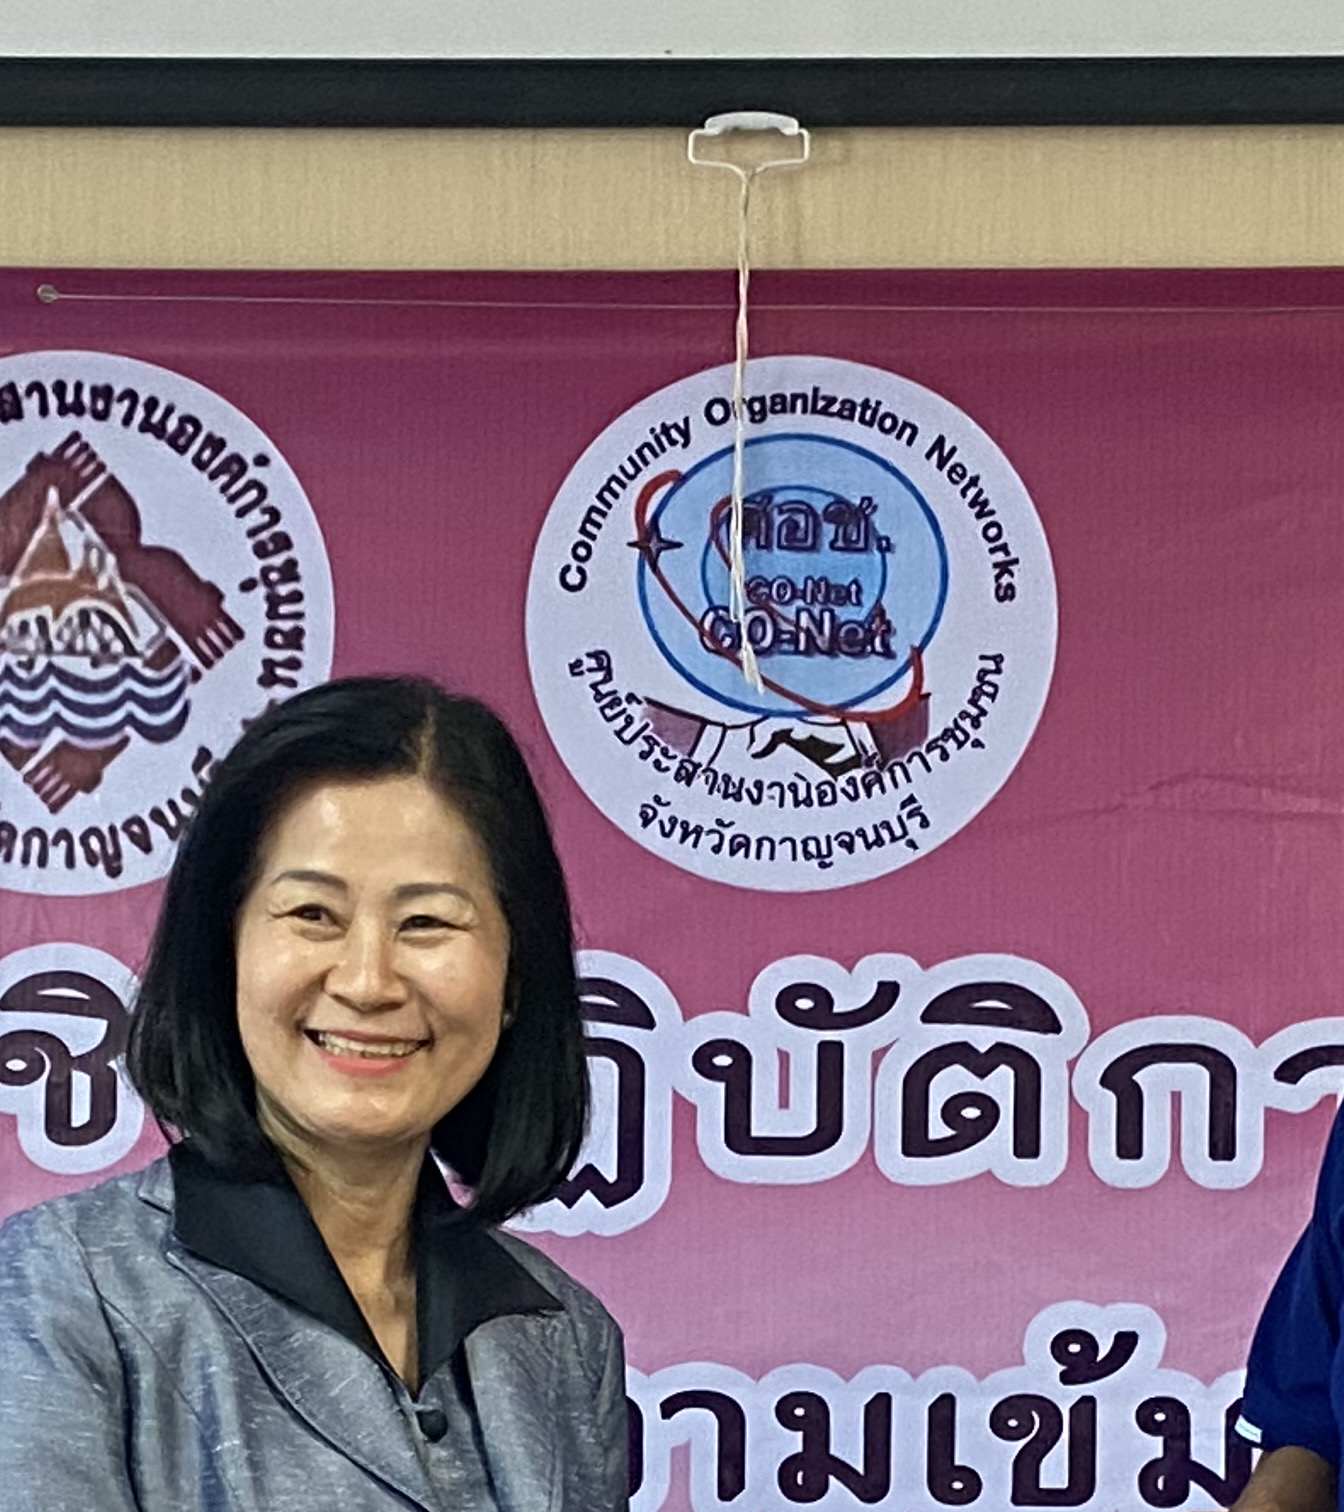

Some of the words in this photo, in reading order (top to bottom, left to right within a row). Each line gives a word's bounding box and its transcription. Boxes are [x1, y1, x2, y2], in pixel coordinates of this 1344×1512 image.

[560, 416, 694, 594] Community
[925, 435, 1021, 604] Networks
[700, 605, 896, 659] CO-Net
[637, 795, 932, 869] จังหวัดกาญจนบุรี
[628, 1329, 1253, 1508] ามเข้ม
